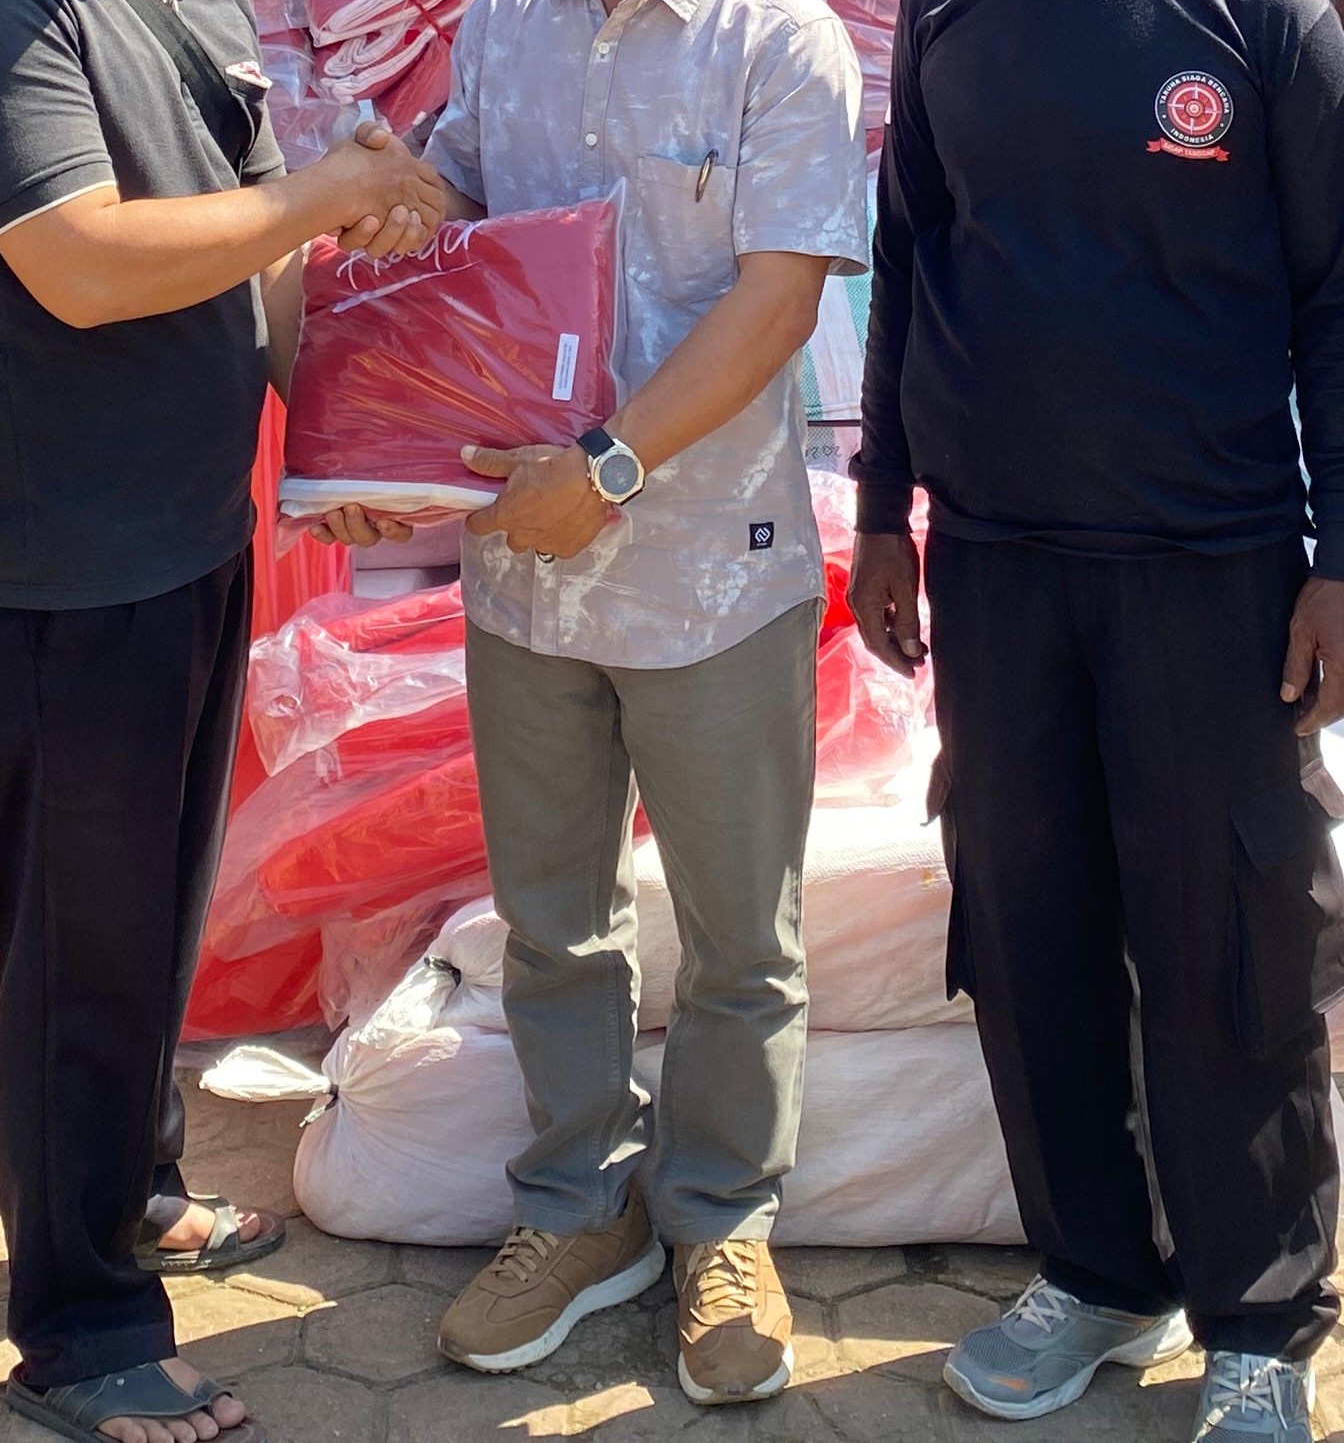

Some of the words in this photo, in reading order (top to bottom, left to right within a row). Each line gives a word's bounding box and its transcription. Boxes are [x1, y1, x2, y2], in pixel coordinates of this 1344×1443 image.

[1159, 78, 1182, 104] TARUNA
[1181, 75, 1206, 83] SIAGA
[1207, 79, 1230, 114] BENCANA
[1170, 127, 1214, 144] INDONESIA
